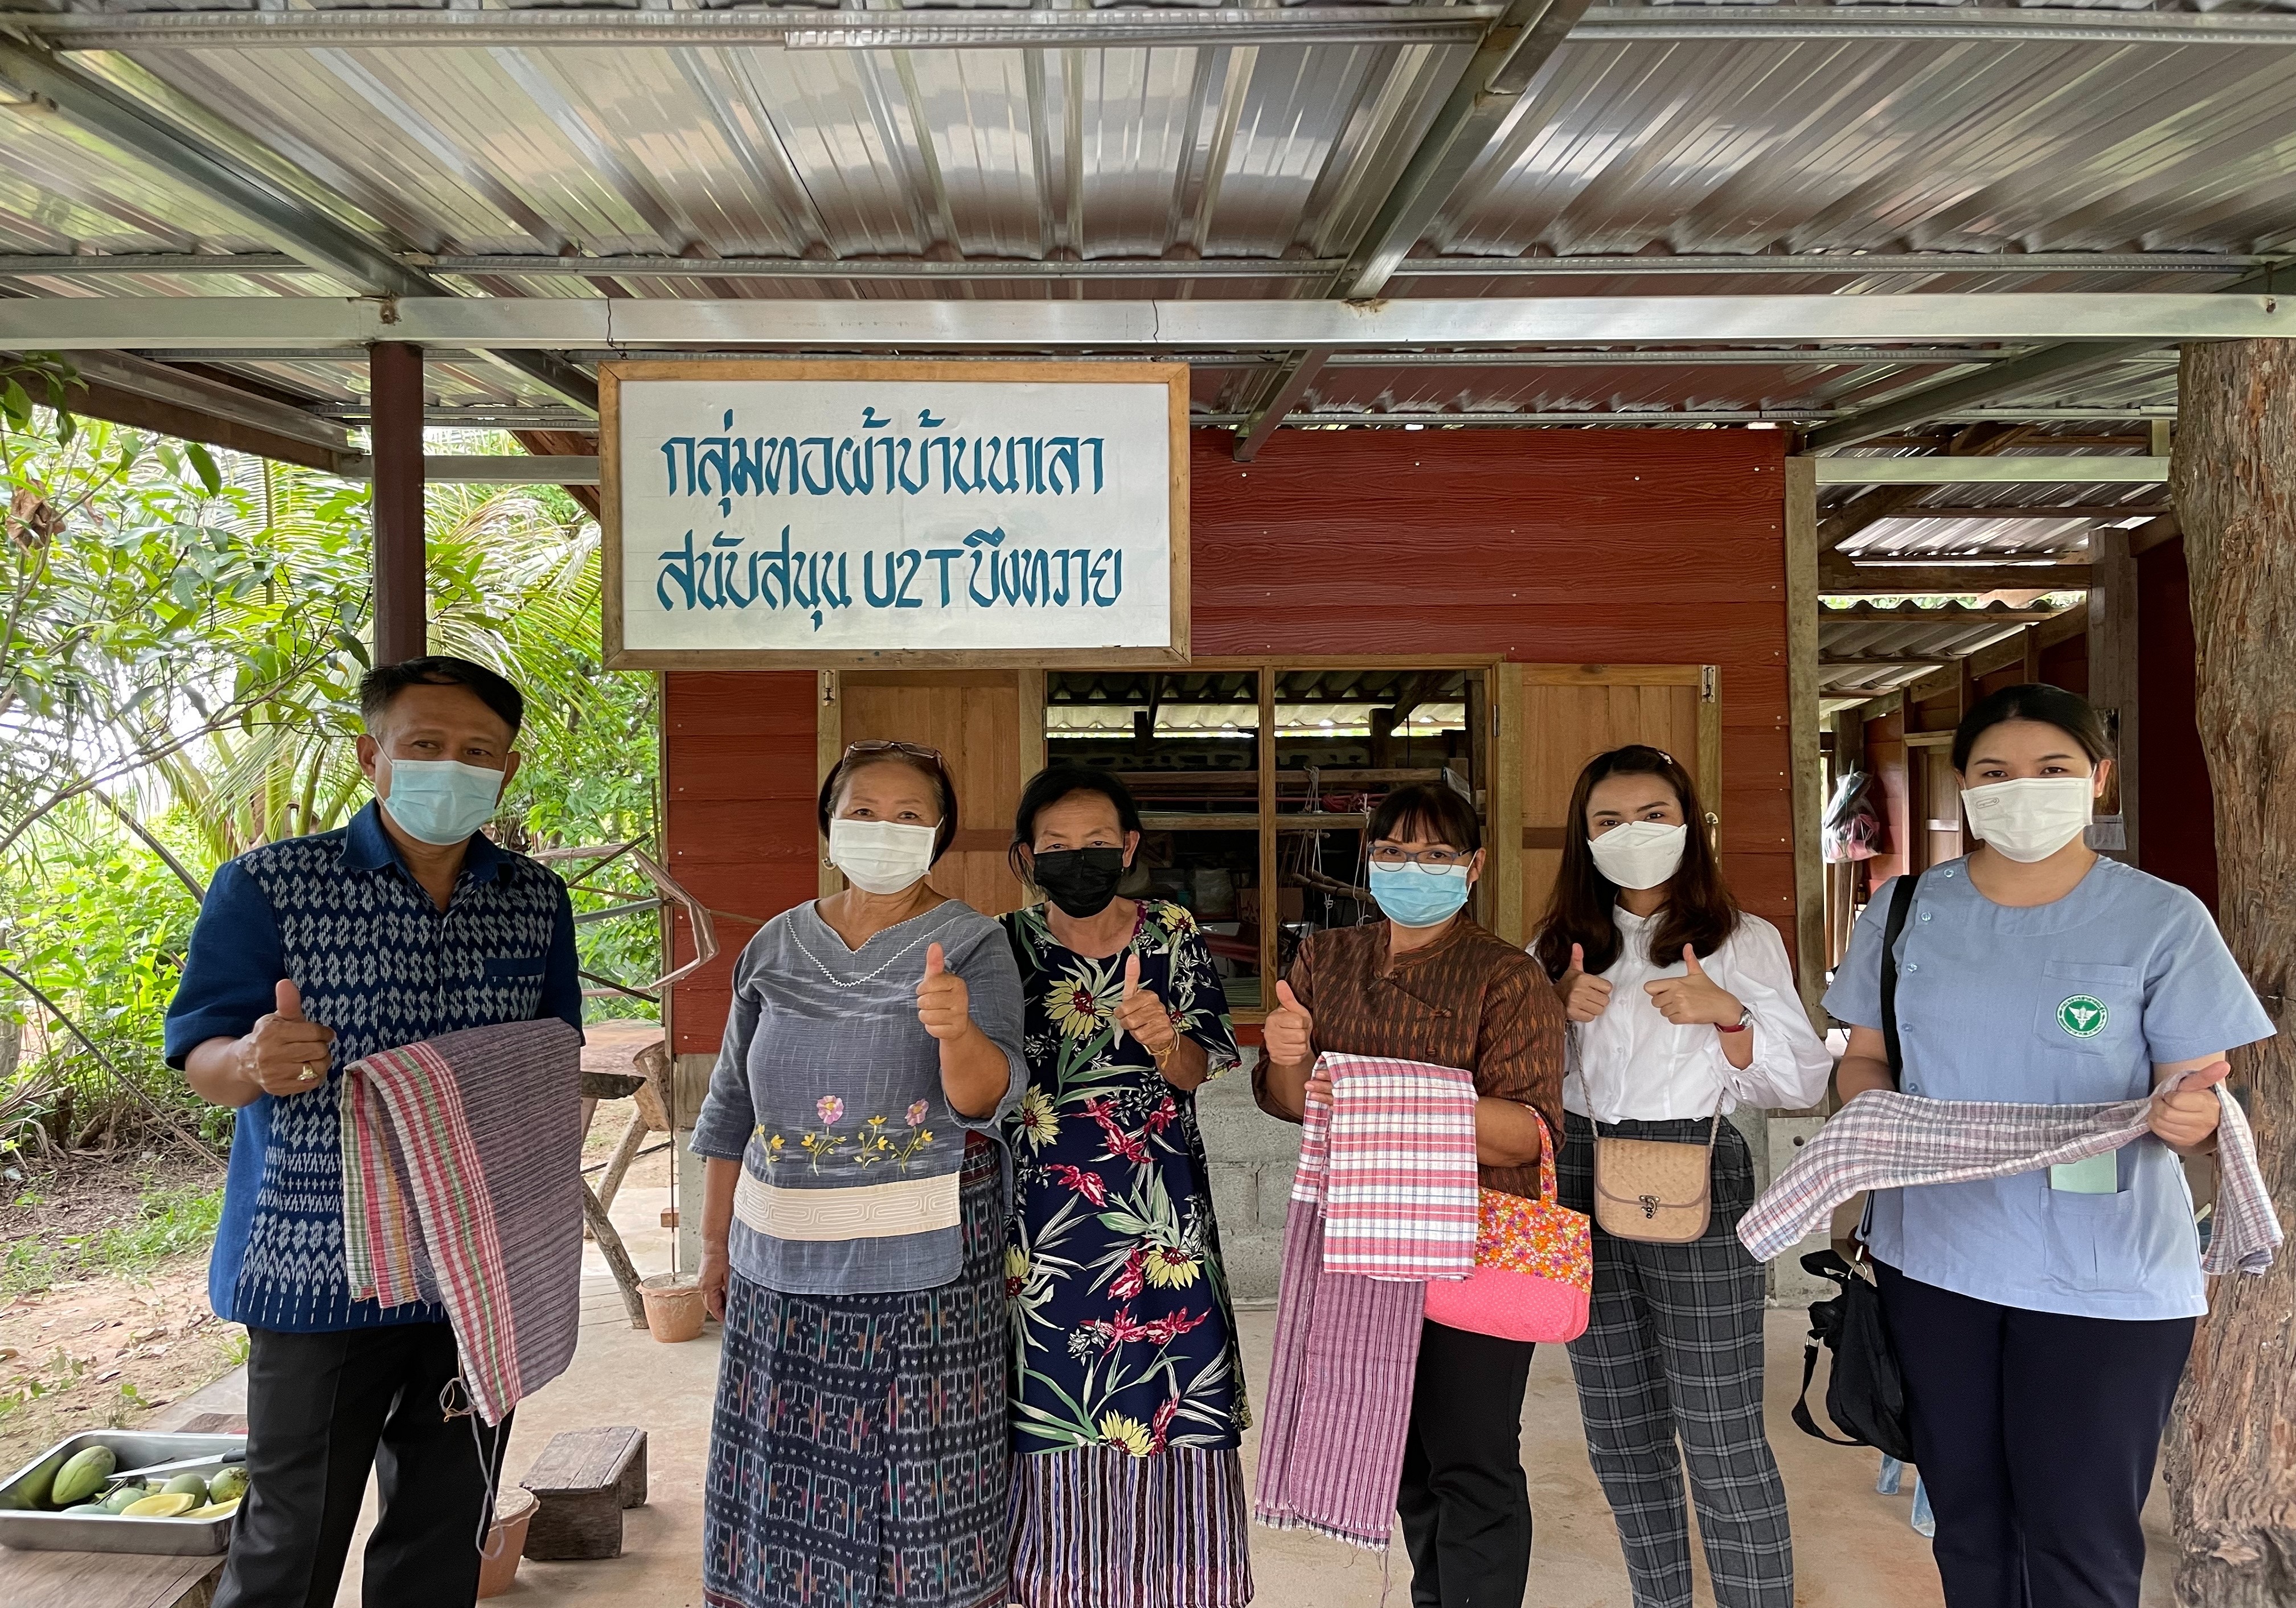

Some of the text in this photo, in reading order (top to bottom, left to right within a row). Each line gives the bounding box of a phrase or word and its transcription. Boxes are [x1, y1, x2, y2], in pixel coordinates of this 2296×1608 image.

[661, 407, 1105, 518] กลุ่มทอผ้าบ้านนาเลา
[657, 524, 1122, 633] สนับสนุน U2T บึงทวาย
